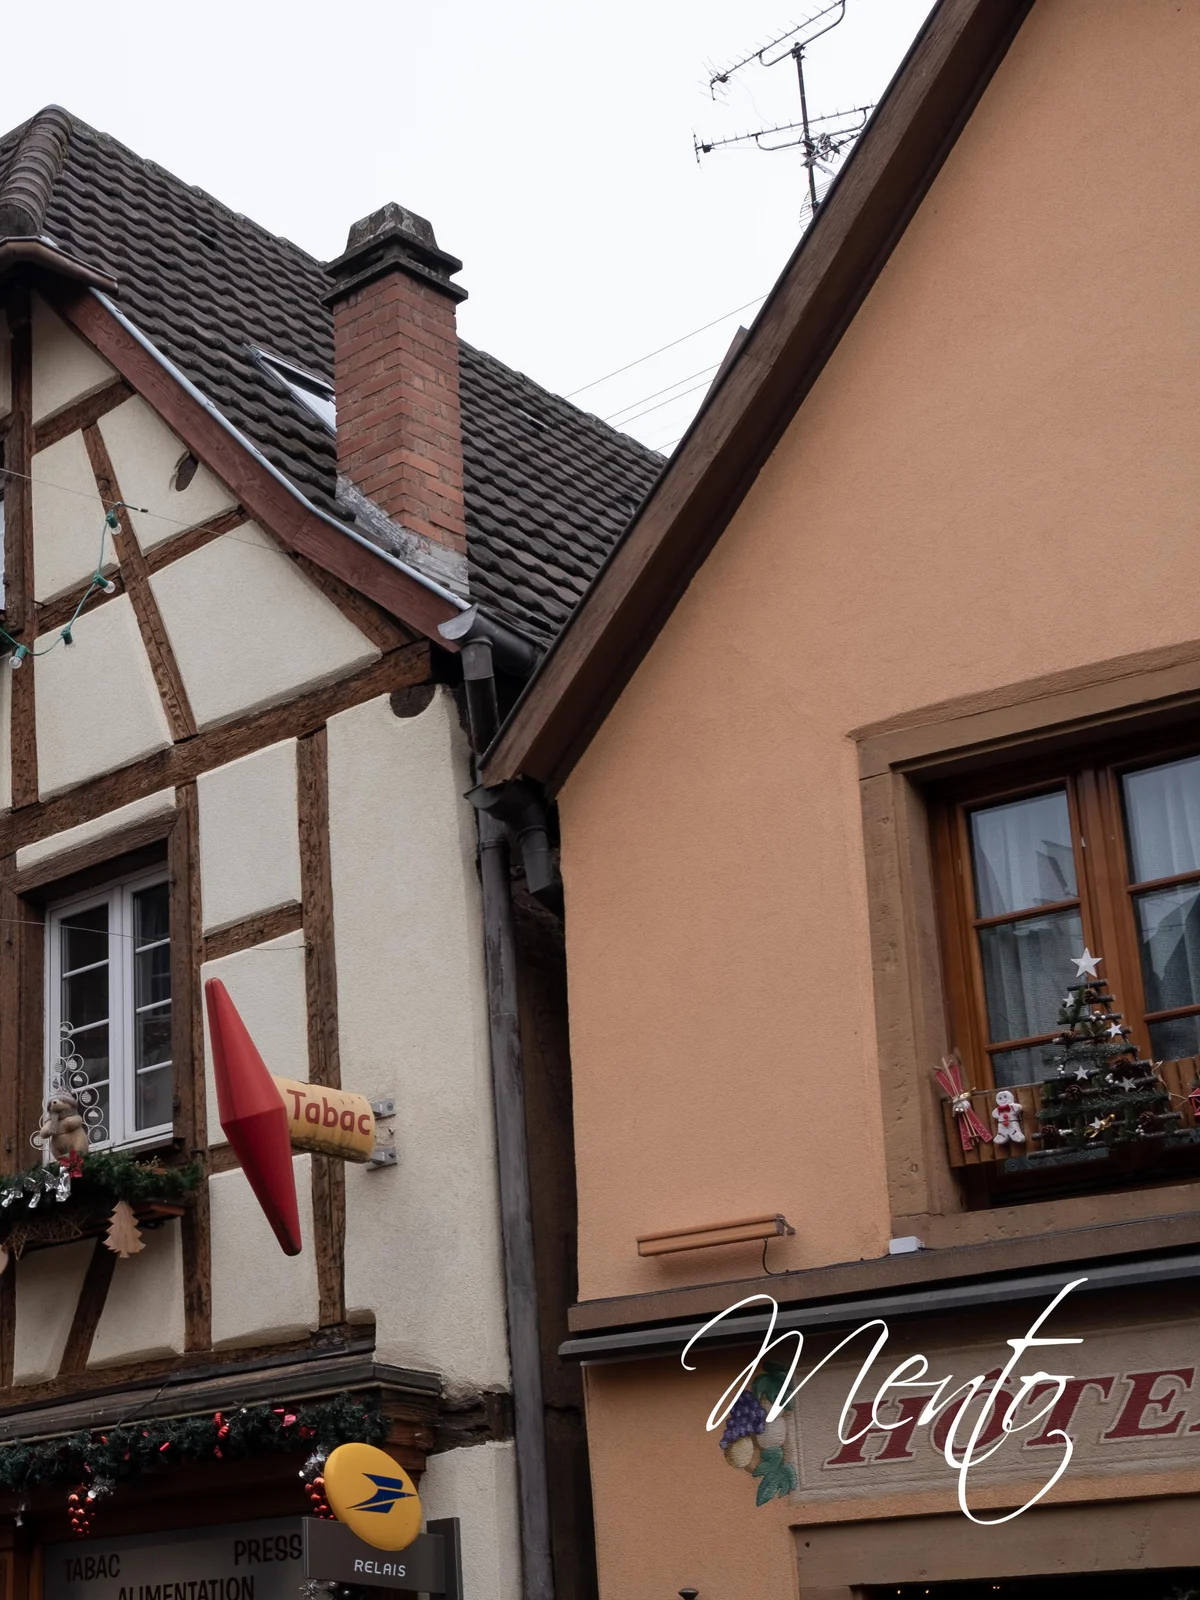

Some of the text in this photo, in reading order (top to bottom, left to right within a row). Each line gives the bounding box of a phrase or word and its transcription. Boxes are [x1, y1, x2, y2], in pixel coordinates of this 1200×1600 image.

[286, 1089, 371, 1135] Tabac
[826, 1367, 1200, 1465] HÔTE
[65, 1554, 120, 1583] TABAC
[354, 1559, 406, 1577] RELAIS
